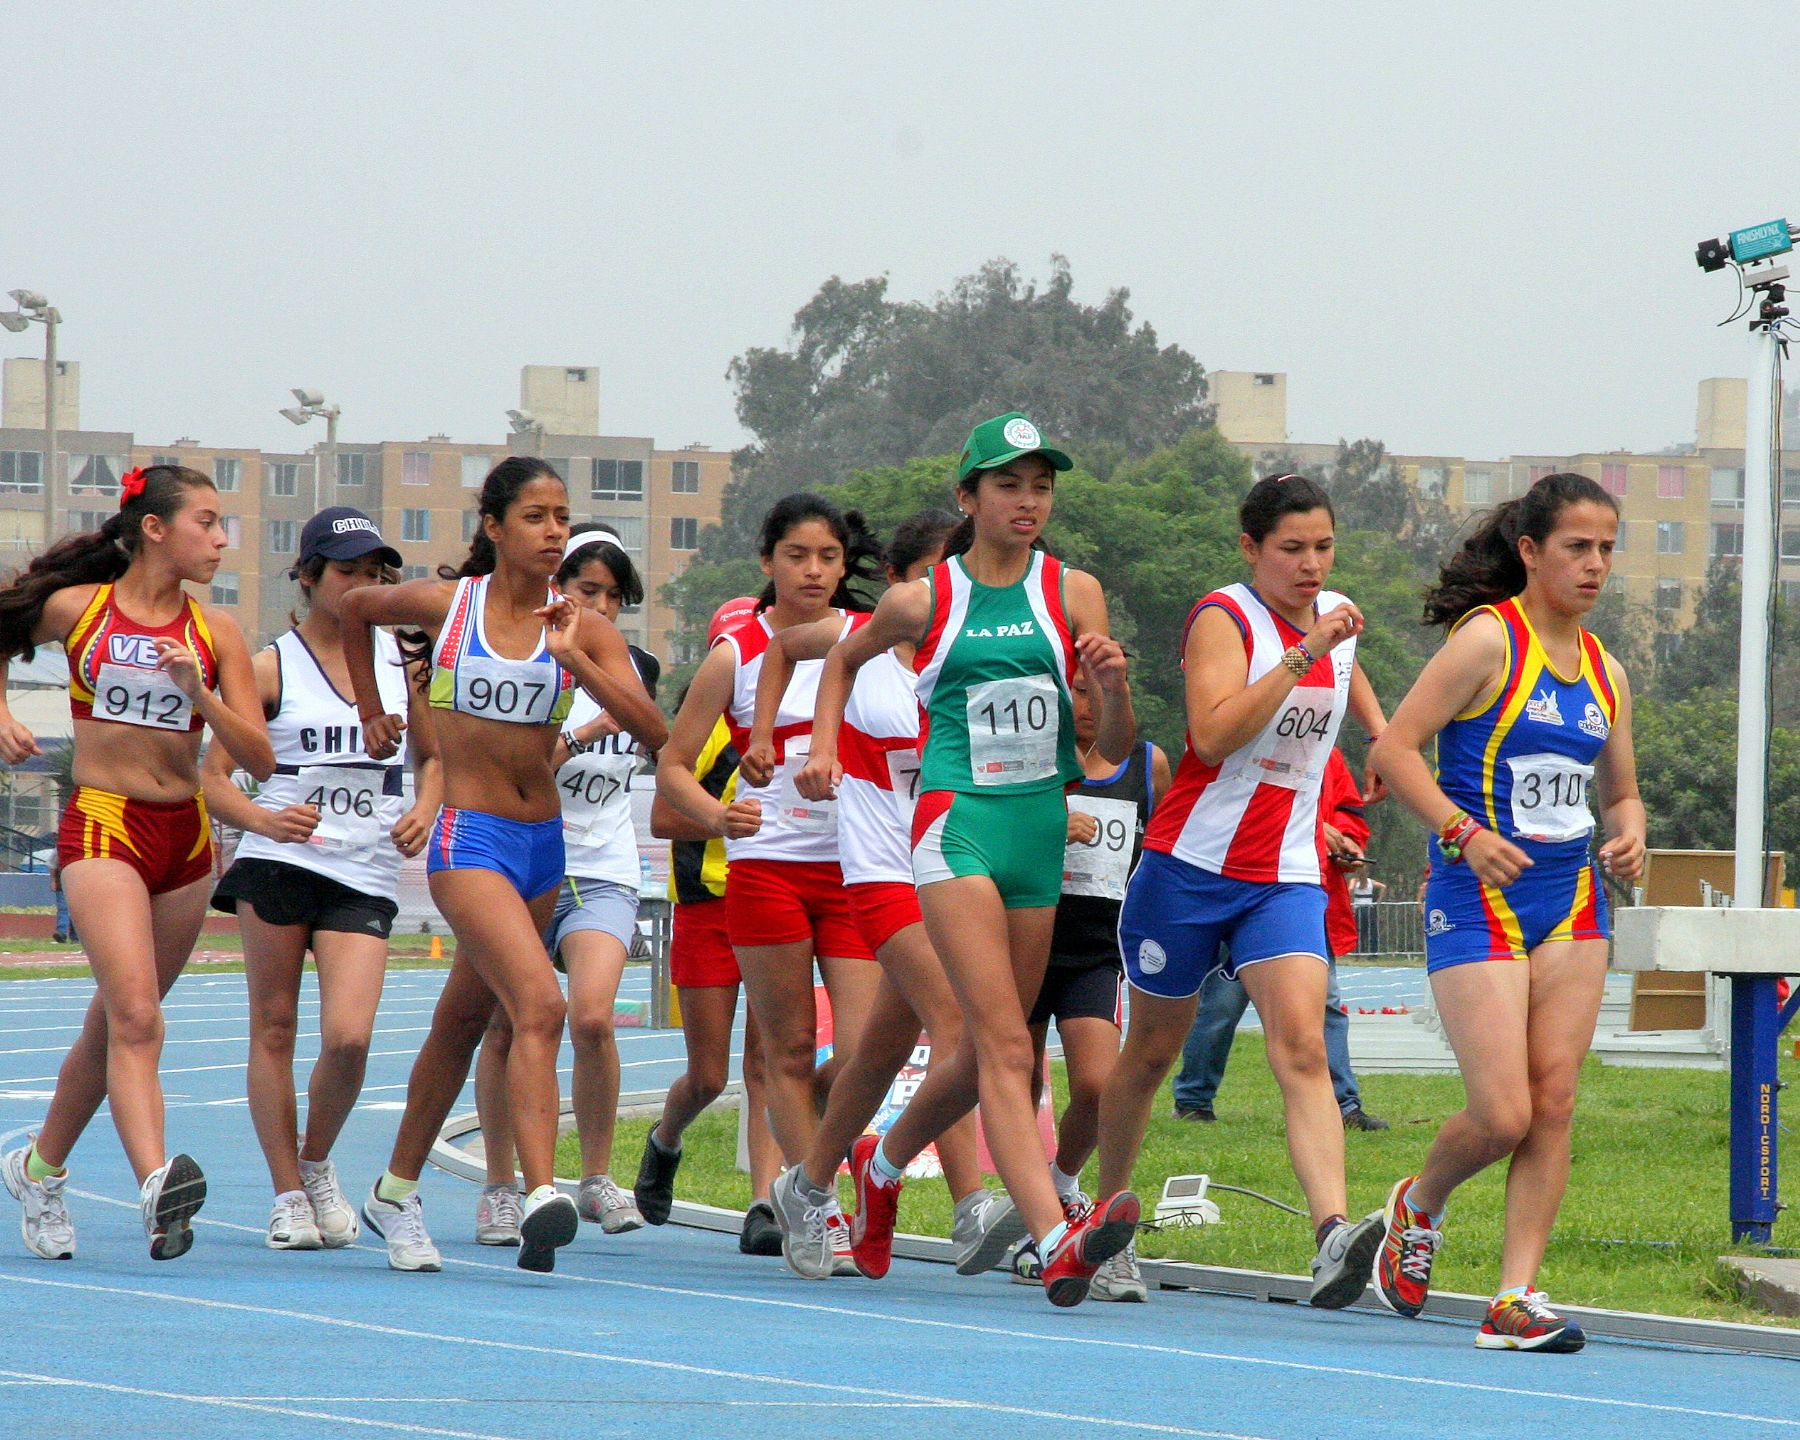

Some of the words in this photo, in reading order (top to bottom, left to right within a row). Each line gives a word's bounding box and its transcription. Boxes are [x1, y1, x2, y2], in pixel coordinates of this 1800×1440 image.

[966, 629, 993, 637] LA
[997, 620, 1034, 637] PAZ
[109, 633, 162, 669] VE
[105, 685, 183, 725] 912
[468, 677, 546, 716] 907
[980, 695, 1047, 735] 110
[300, 726, 368, 753] CHI
[1276, 706, 1333, 741] 604
[304, 785, 374, 818] 406
[561, 769, 621, 807] 407
[1520, 772, 1582, 809] 310
[1761, 1083, 1770, 1197] NORDICSPORT
